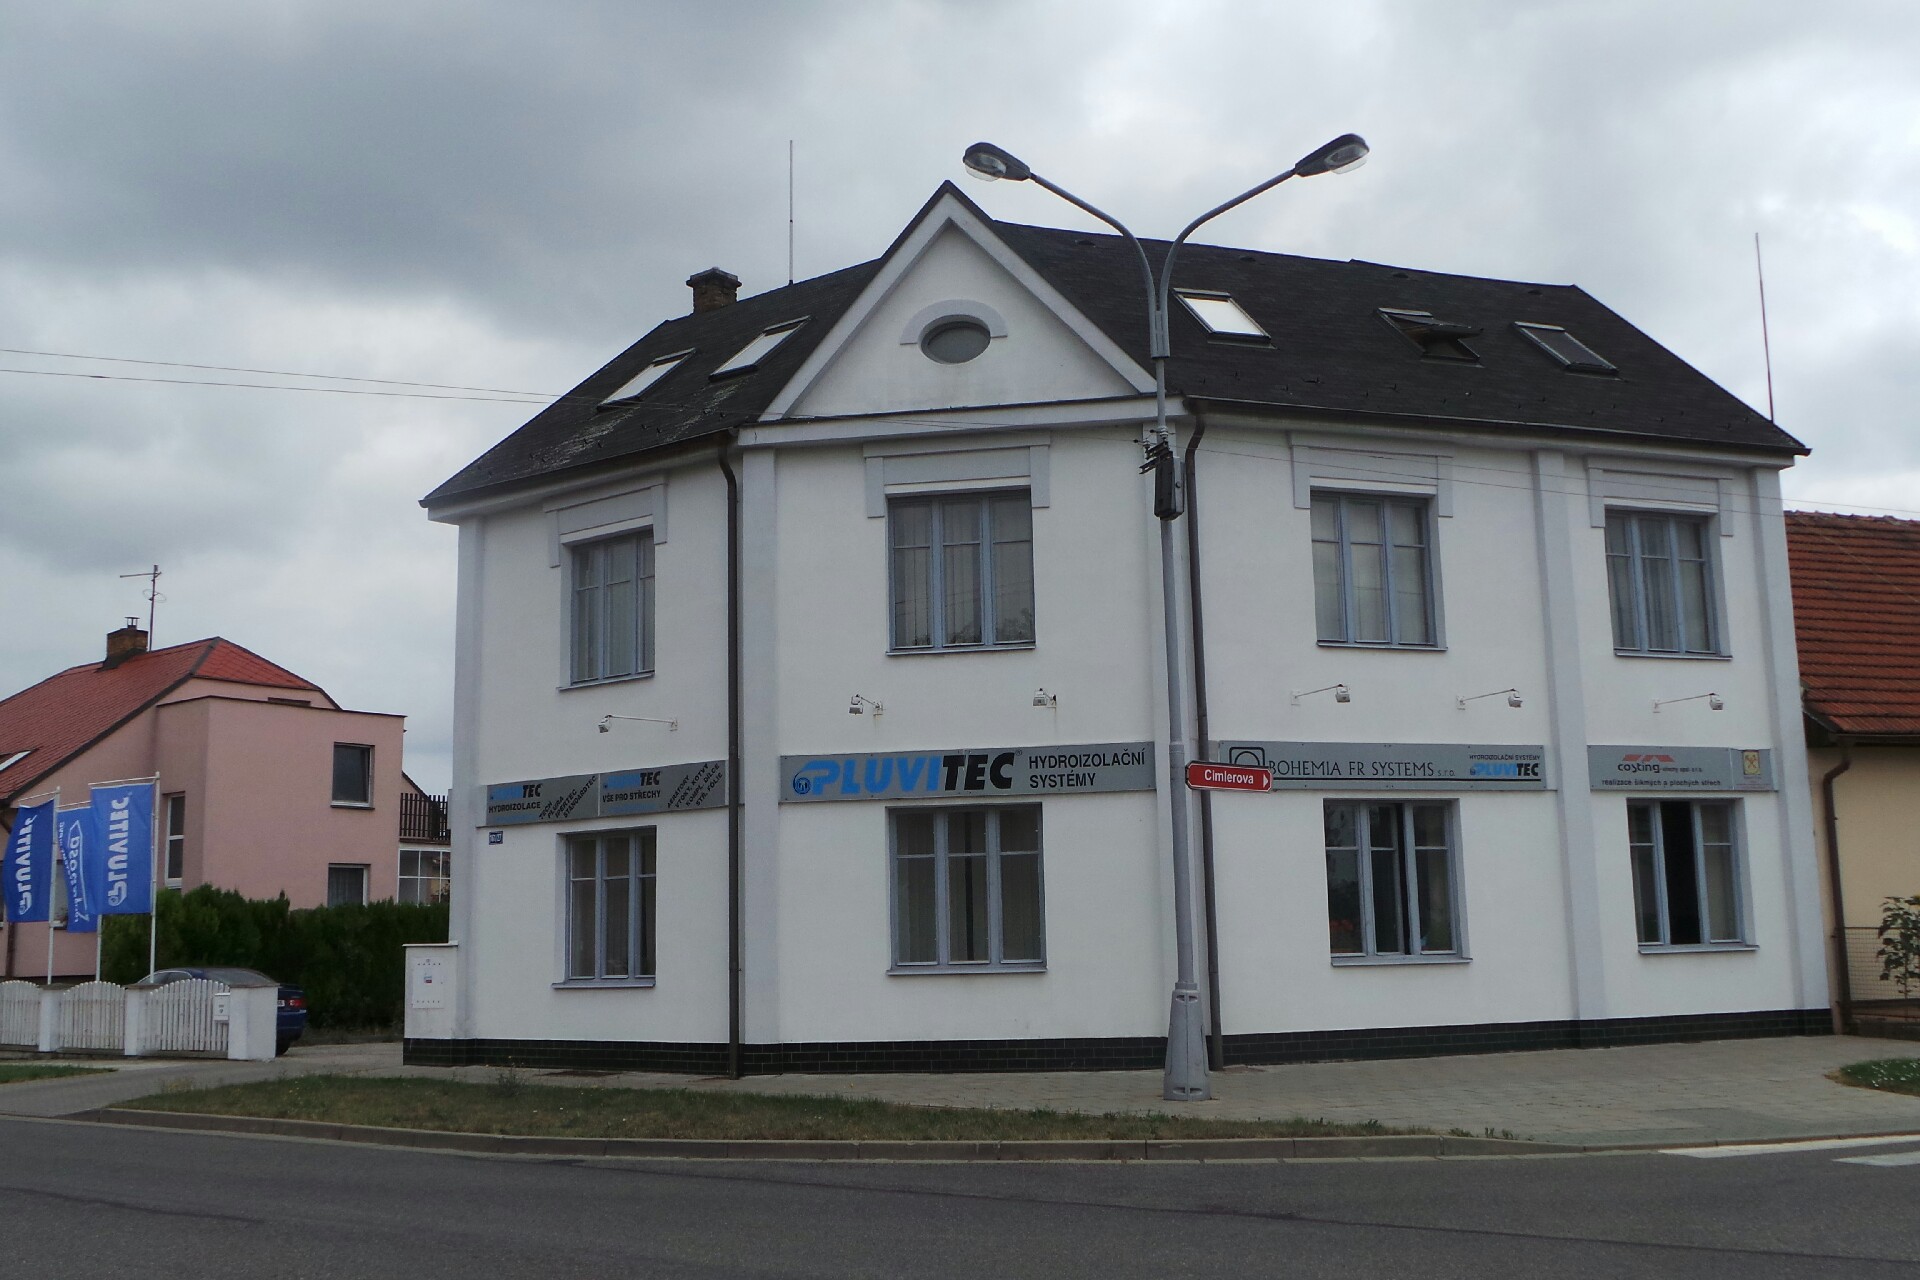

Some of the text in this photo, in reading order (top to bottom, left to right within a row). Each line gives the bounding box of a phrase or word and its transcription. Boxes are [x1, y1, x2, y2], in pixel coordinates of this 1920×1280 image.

[1029, 747, 1145, 769] HYDROIZOLAČNÍ
[793, 752, 1016, 795] PLUVITEC
[1269, 760, 1342, 776] BOHEMIA
[1349, 761, 1364, 776] FR
[1372, 761, 1434, 777] SYSTEMS
[1617, 761, 1660, 773] costing
[1029, 770, 1097, 789] SYSTÉMY
[1204, 769, 1254, 784] Cimlerova
[602, 789, 661, 803] VŠE PRO STŘECHY
[488, 801, 541, 813] HYDROIZOLACE
